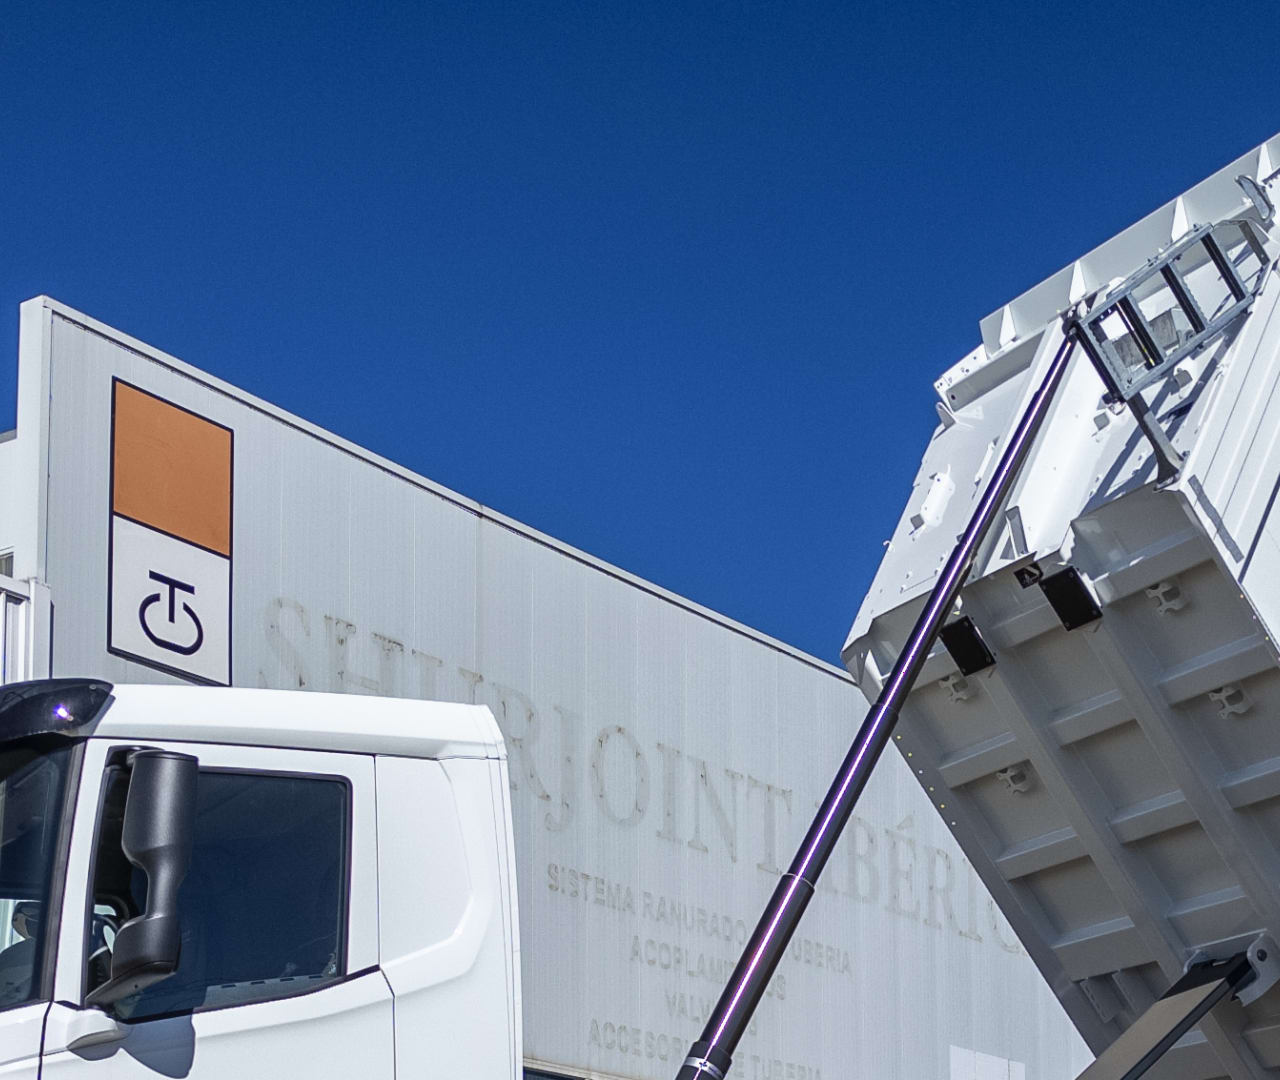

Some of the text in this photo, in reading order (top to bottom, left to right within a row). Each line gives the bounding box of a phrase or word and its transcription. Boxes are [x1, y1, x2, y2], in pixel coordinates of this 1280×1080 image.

[546, 862, 853, 976] SISTEMA RANURADO UBERIA
